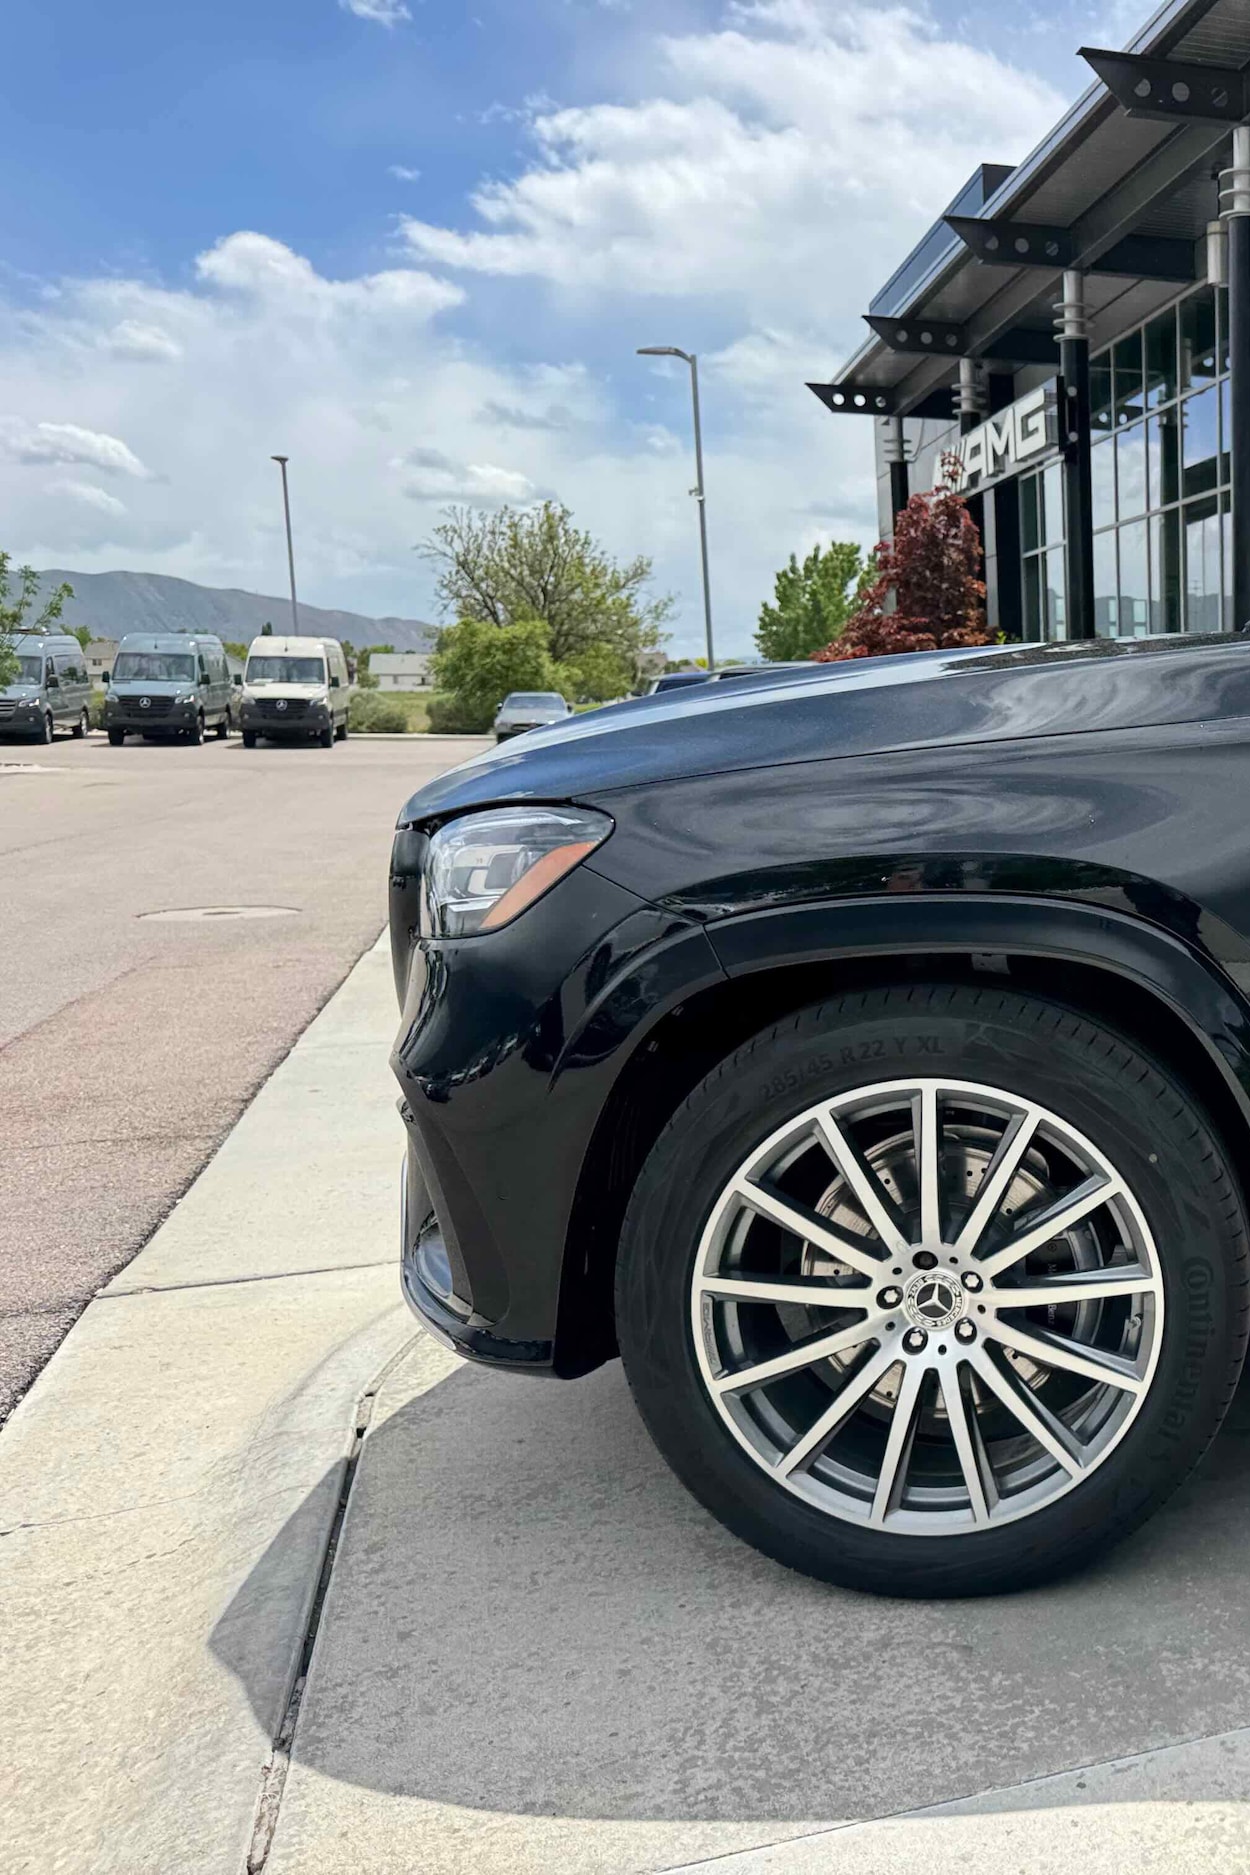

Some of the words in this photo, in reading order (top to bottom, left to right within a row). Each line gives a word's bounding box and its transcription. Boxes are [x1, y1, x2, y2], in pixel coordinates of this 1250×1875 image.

[760, 1053, 833, 1098] 285/45
[893, 1037, 908, 1055] Y
[917, 1035, 945, 1054] XL
[1160, 1257, 1214, 1440] Continental
